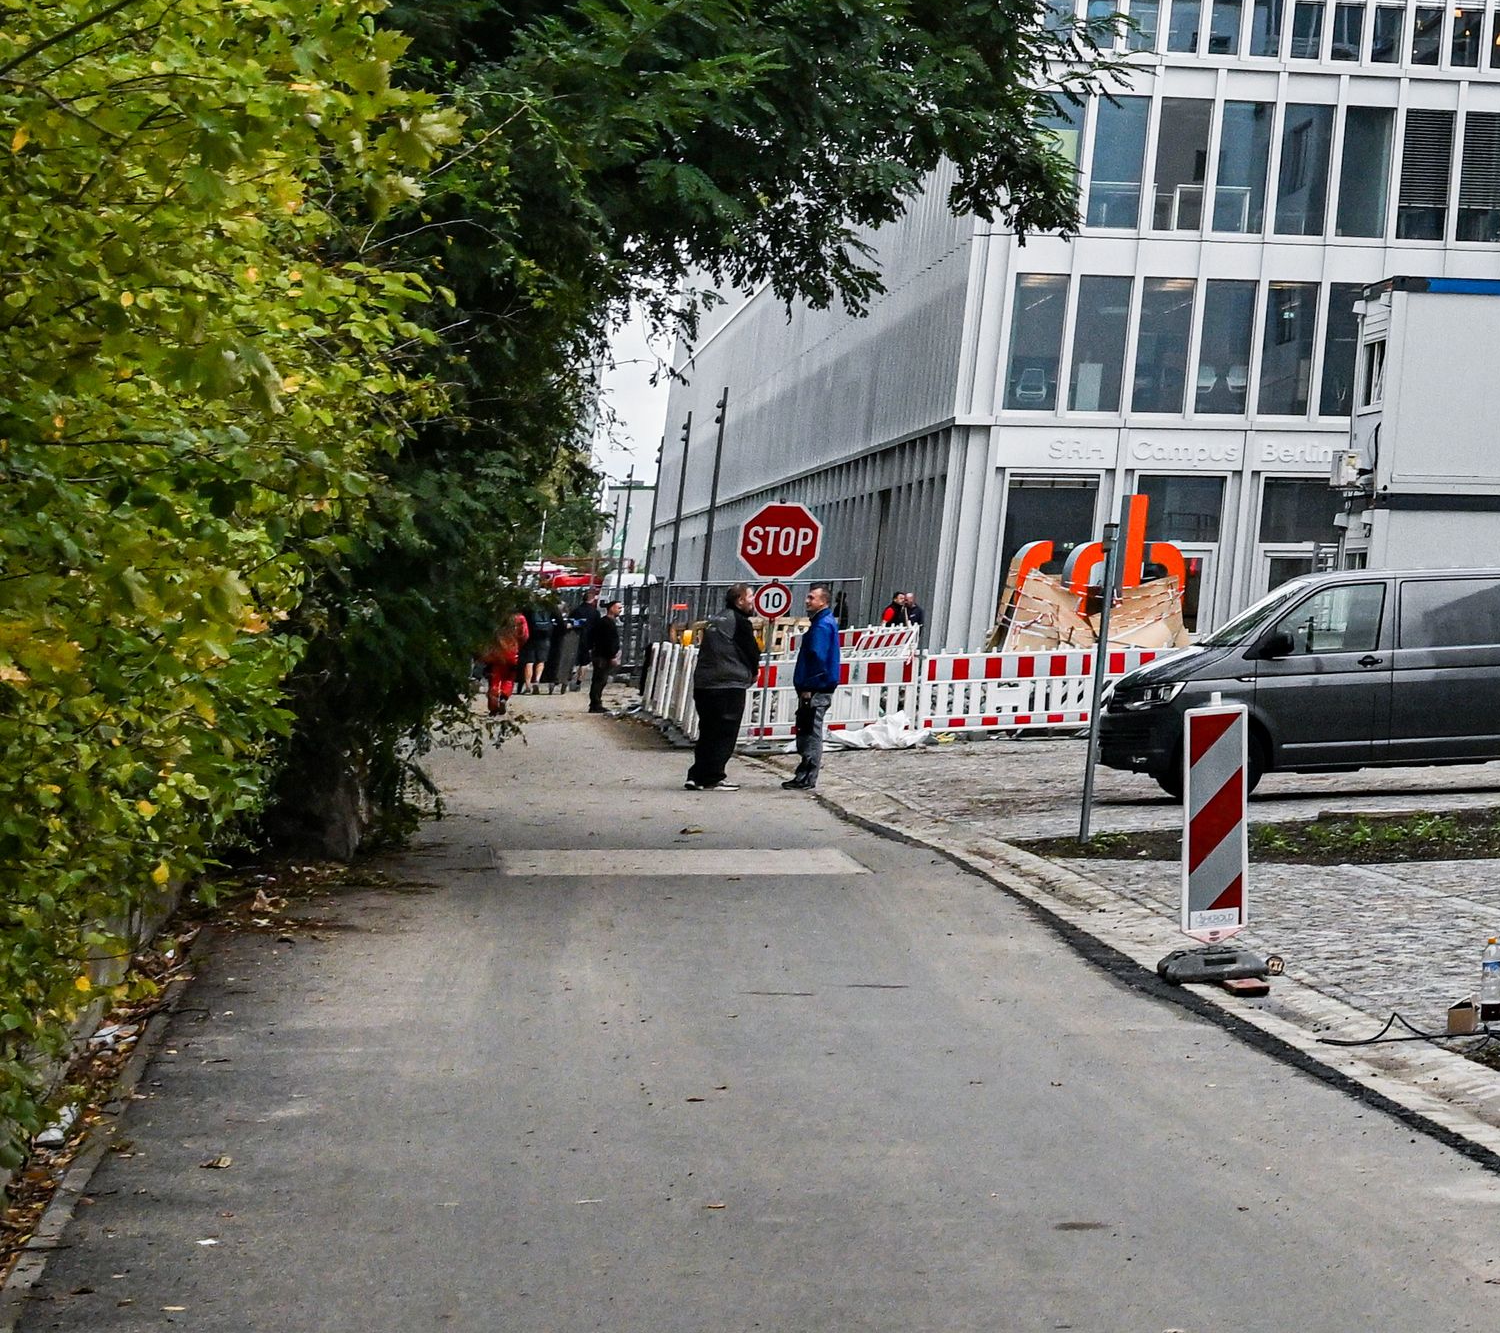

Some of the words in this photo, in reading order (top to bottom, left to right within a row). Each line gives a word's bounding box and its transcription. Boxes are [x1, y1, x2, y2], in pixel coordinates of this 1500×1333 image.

[1049, 439, 1105, 461] SRH
[1132, 440, 1239, 467] Campus
[1260, 441, 1334, 463] Berlin
[746, 525, 814, 557] STOP
[763, 592, 783, 609] 10
